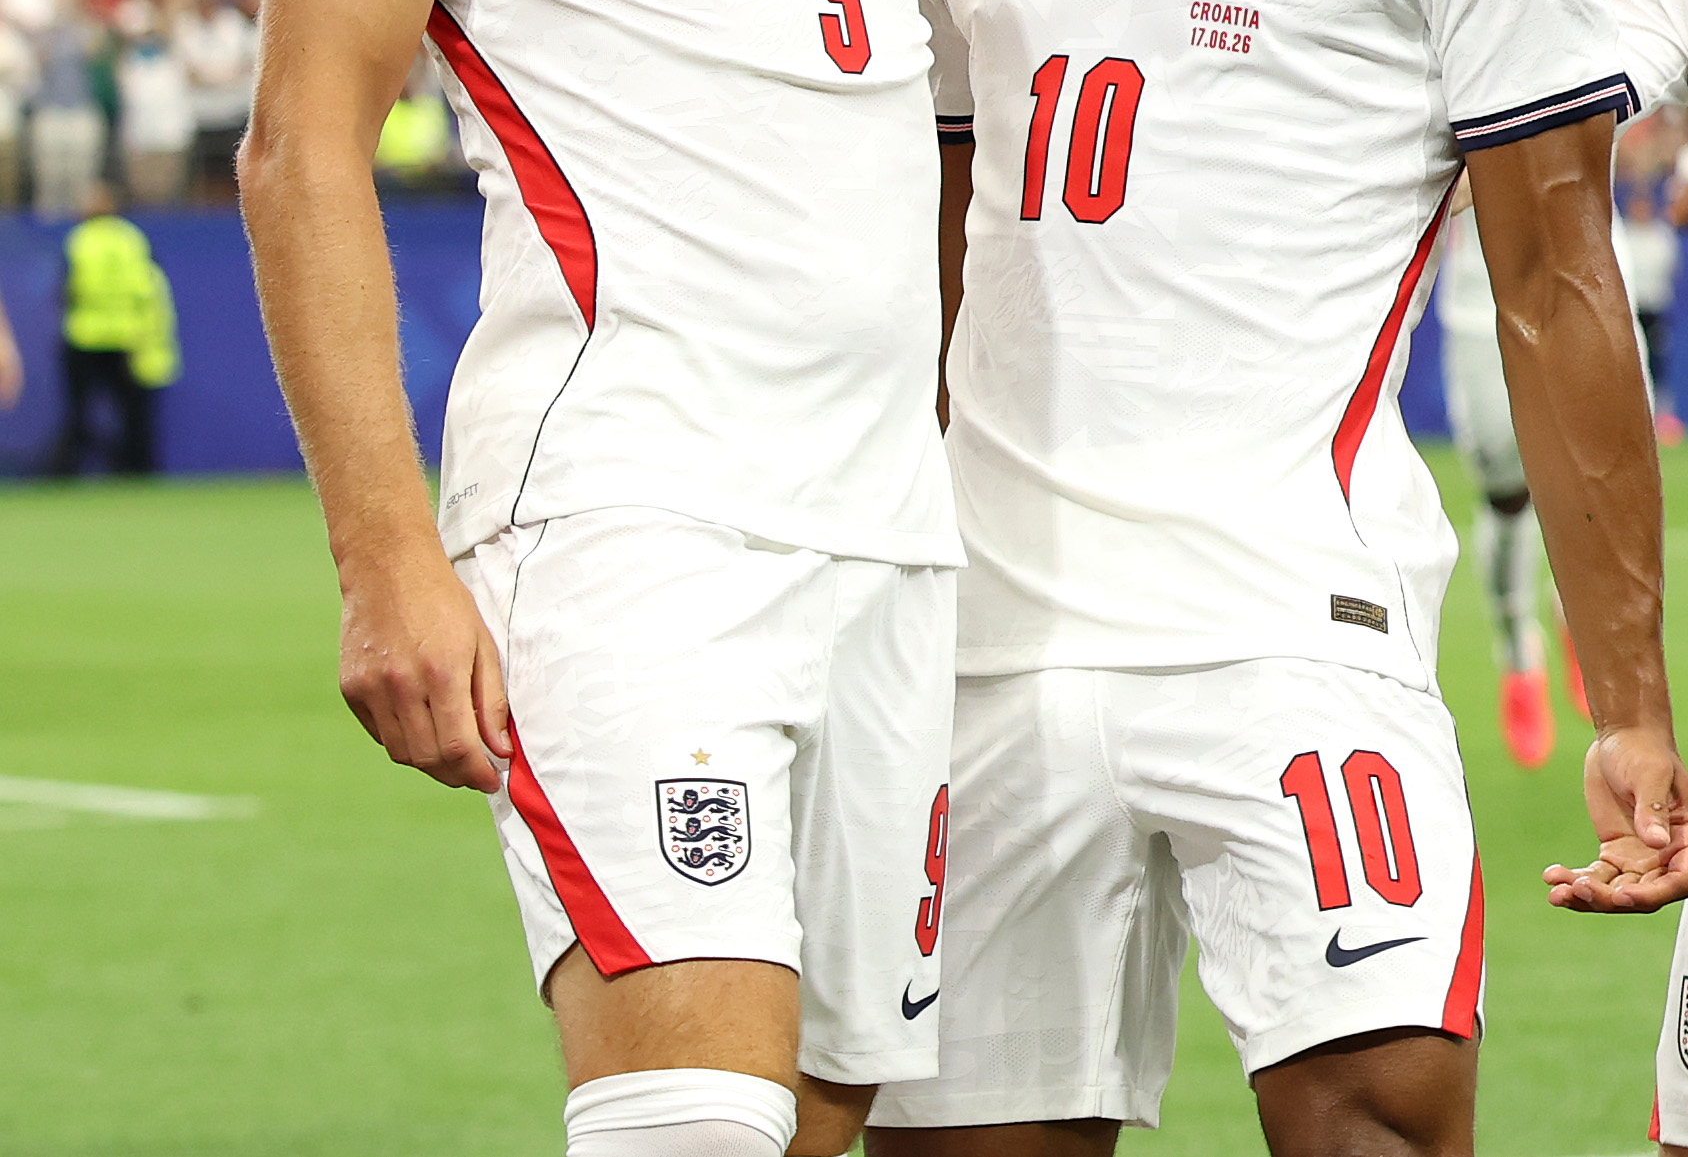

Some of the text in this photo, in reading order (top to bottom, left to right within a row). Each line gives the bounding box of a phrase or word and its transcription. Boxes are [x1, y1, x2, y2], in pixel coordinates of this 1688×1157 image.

[1190, 1, 1260, 30] CROATIA
[1190, 27, 1251, 54] 17.06.26
[1019, 54, 1146, 225] 10
[914, 783, 951, 958] 9
[1279, 748, 1424, 912] 10
